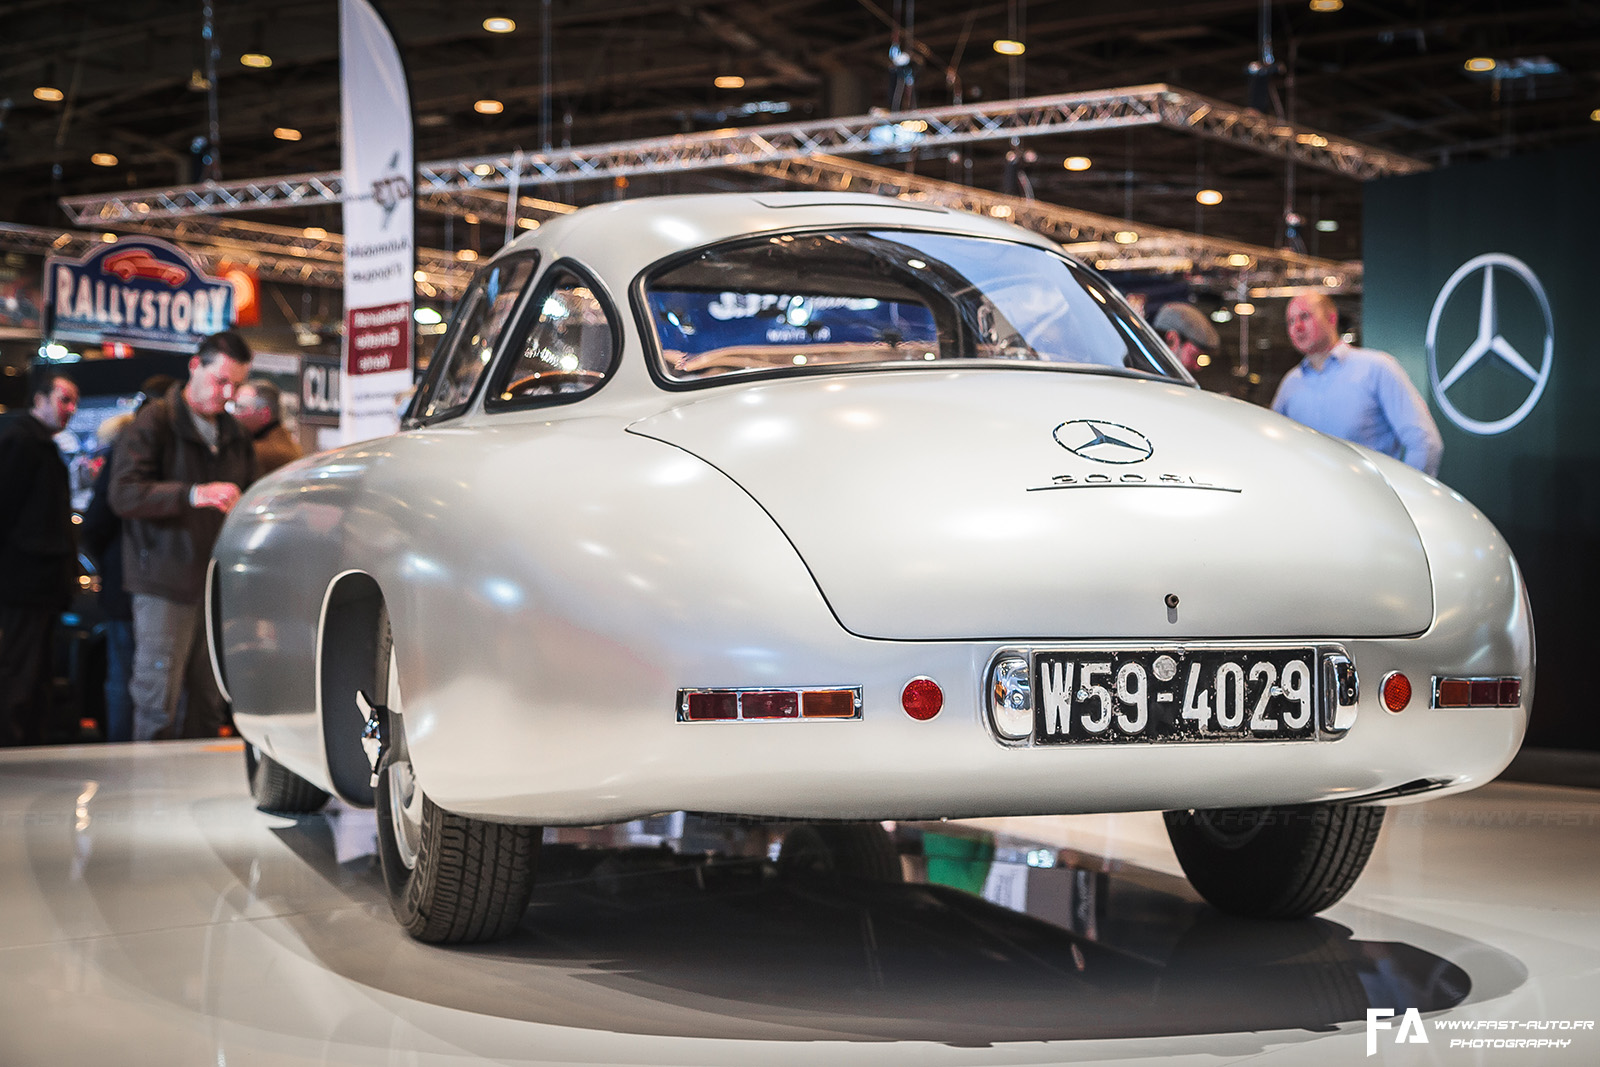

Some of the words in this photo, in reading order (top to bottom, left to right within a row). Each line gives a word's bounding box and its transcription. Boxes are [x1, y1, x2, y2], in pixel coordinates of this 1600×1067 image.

[56, 265, 229, 334] RALLYSTORY
[1051, 473, 1147, 484] 300
[1159, 473, 1213, 486] SL
[1041, 659, 1311, 735] W59-4029
